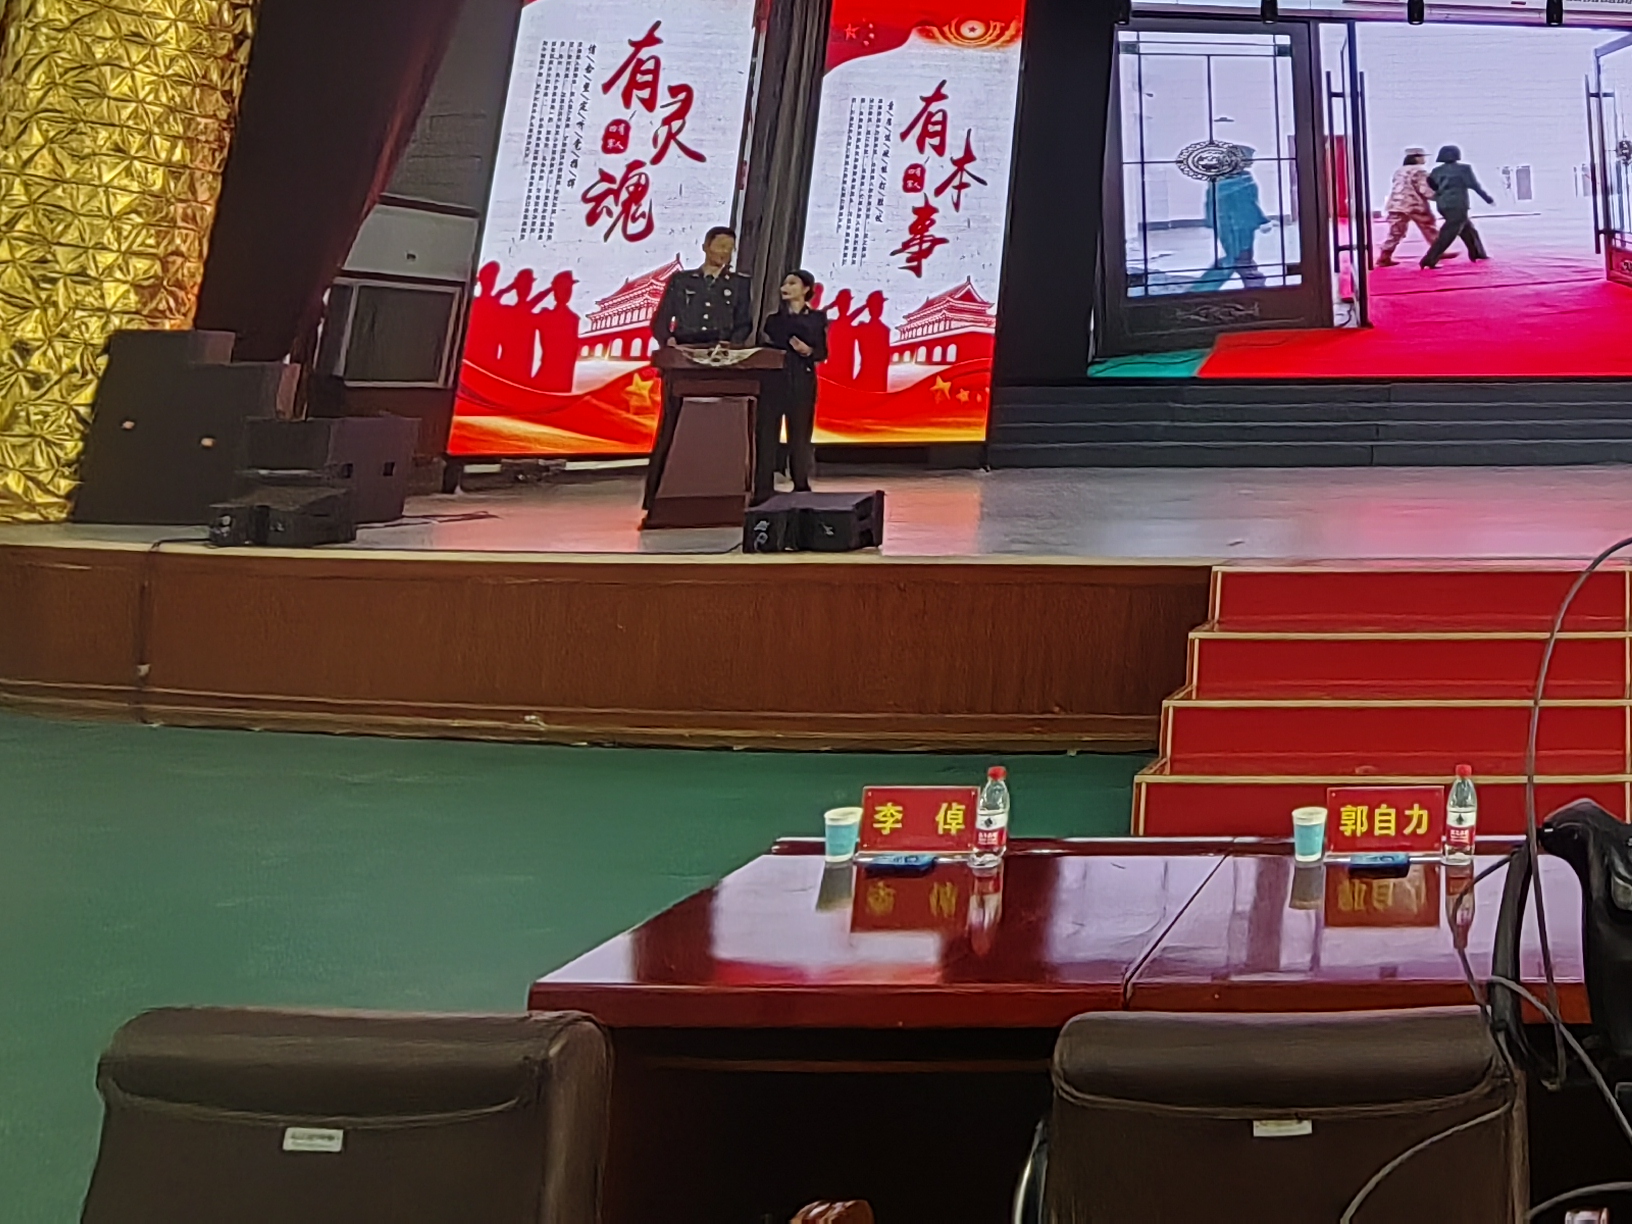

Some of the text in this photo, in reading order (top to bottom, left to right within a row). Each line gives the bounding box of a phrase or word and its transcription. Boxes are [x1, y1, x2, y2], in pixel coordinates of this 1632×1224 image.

[581, 20, 707, 243] 有灵魂
[889, 79, 988, 278] 有本事
[1339, 803, 1429, 837] 郭自力
